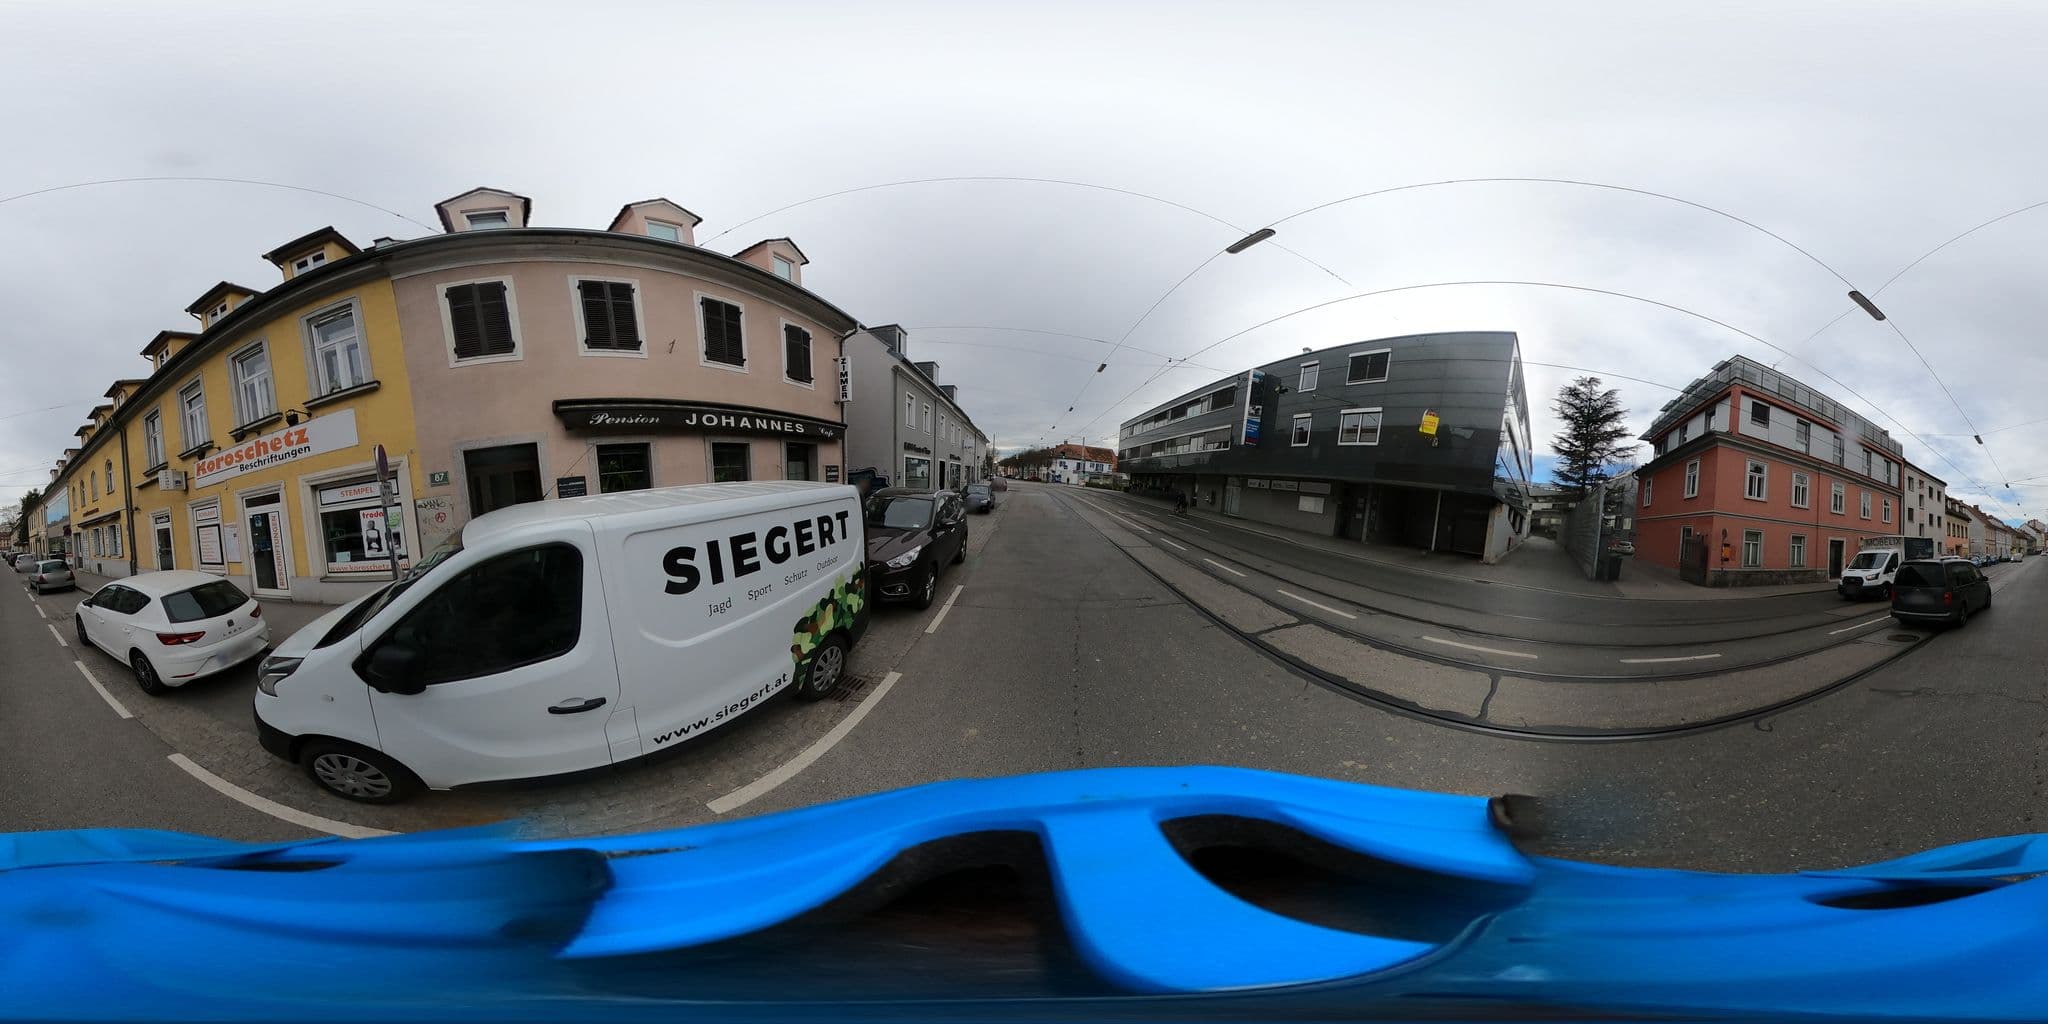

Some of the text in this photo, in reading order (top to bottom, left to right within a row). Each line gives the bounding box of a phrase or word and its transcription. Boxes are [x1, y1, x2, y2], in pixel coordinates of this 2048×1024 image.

[840, 358, 848, 399] ZIMMER
[589, 413, 660, 424] Pension
[686, 413, 804, 433] JOHANNES
[196, 427, 309, 477] Koroschetz
[240, 445, 311, 472] Beschriftungen
[341, 486, 374, 497] STEMPEL
[434, 473, 444, 481] 87
[271, 515, 285, 587] BESCHRIFTUNGEN
[663, 510, 849, 595] SIEGERT
[708, 555, 838, 616] Jagd Sport Schutz Outdoor
[653, 673, 787, 744] www.siegert.at
